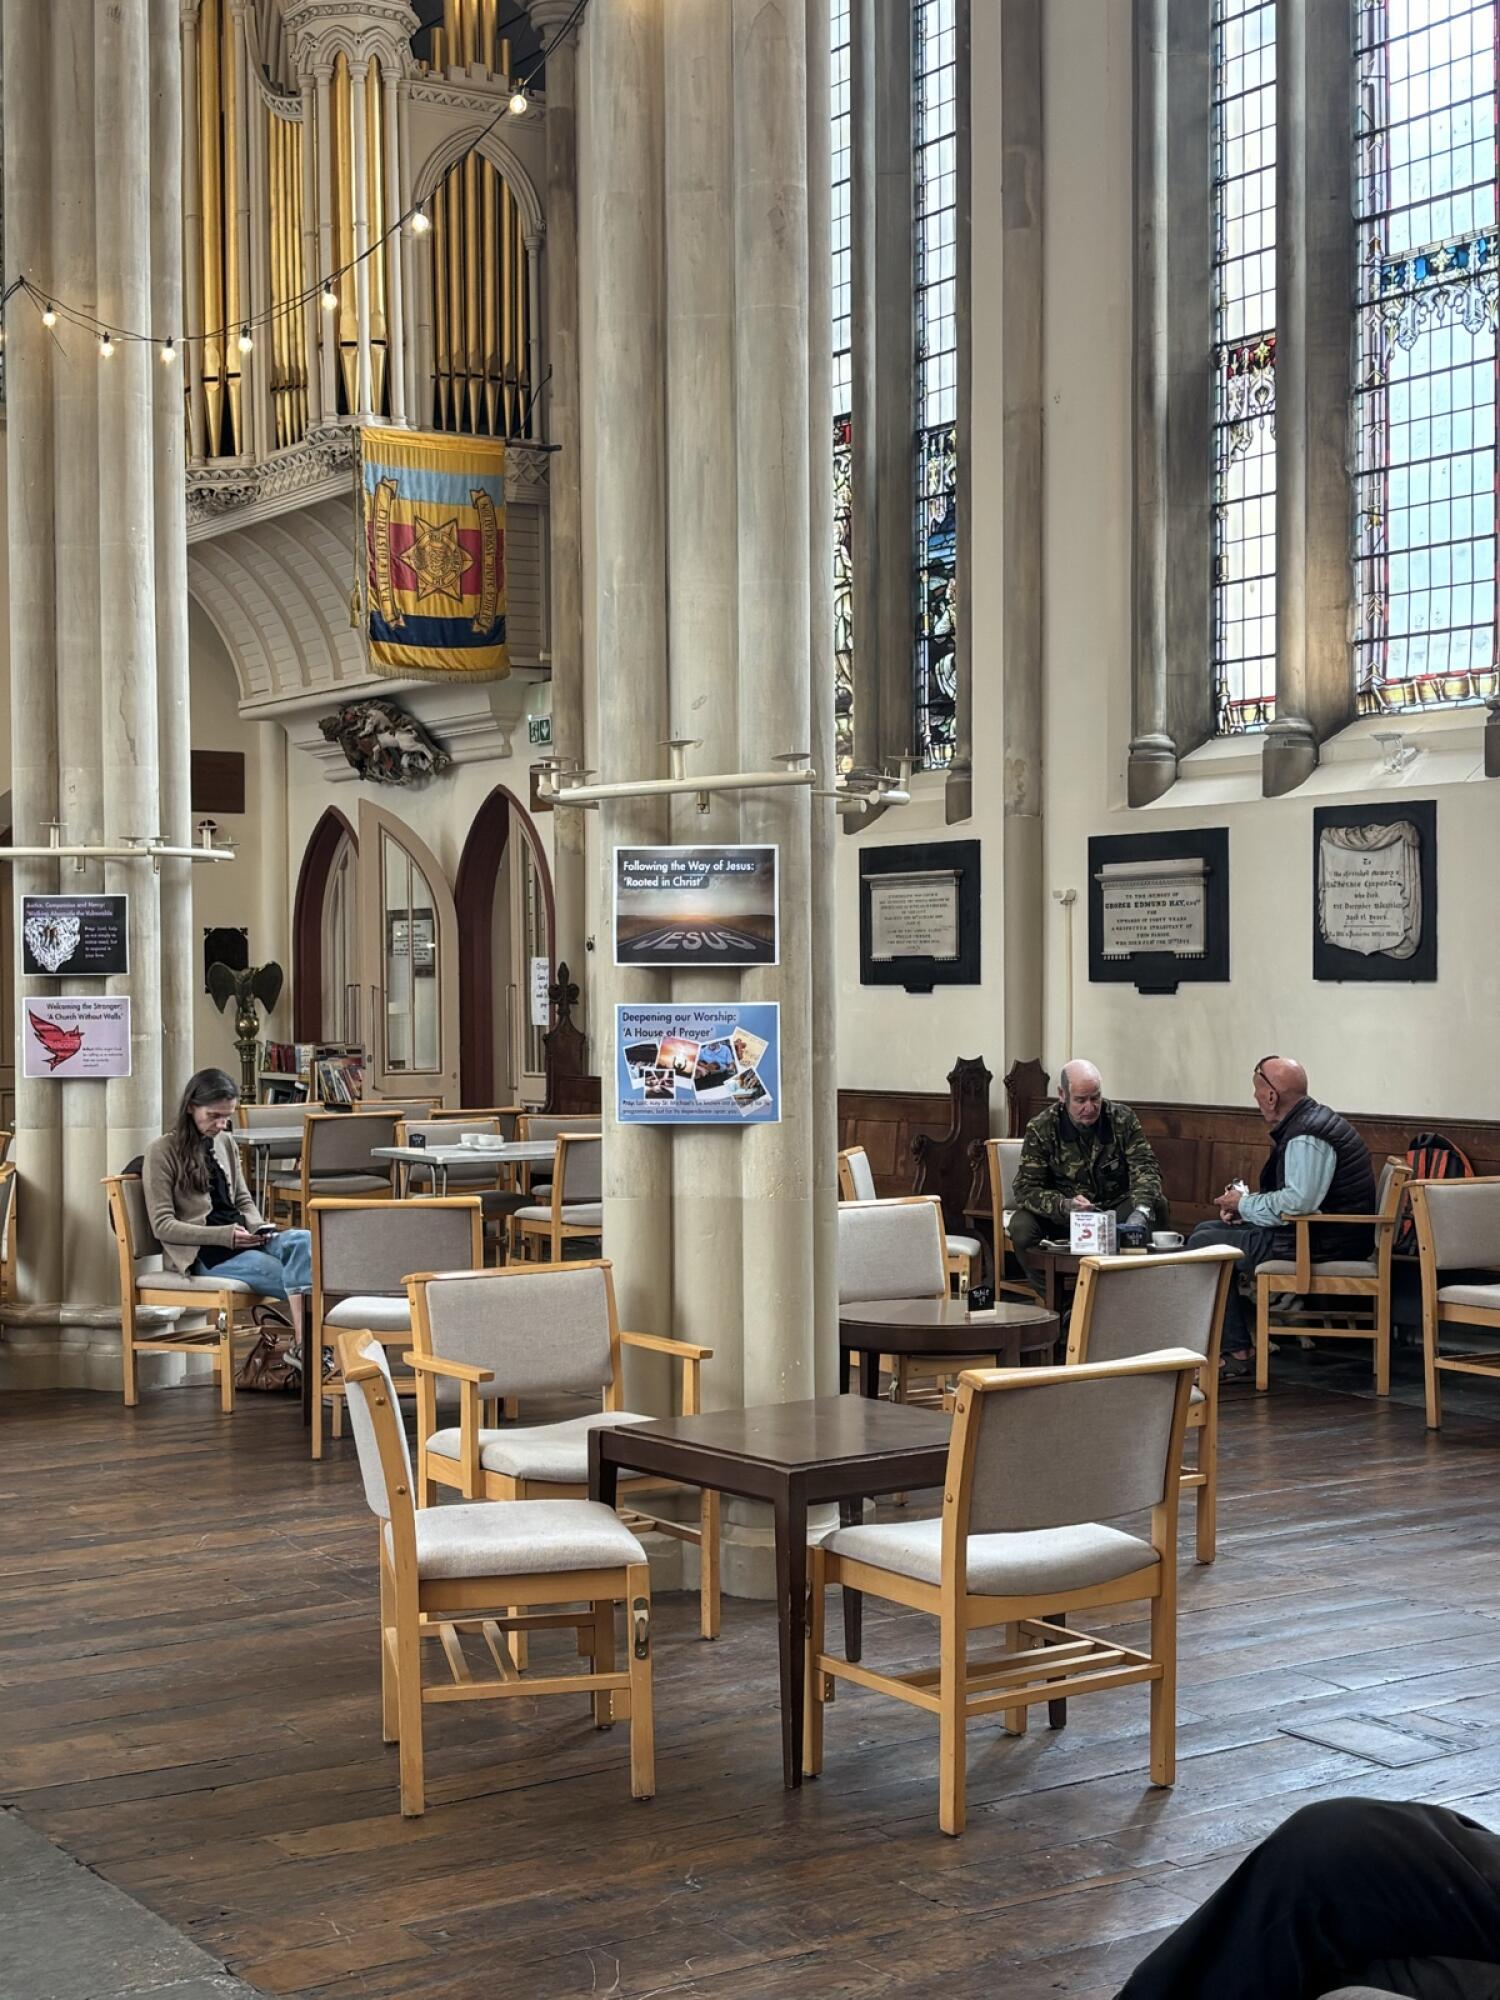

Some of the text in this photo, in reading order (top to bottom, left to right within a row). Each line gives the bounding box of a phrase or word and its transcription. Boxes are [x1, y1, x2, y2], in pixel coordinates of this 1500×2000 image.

[624, 860, 755, 873] Following the Way of Jesus:
[661, 877, 670, 887] in
[1134, 900, 1167, 908] EDMUND
[632, 932, 756, 950] JESUS
[47, 1003, 80, 1012] Welcoming
[55, 1012, 77, 1020] Church
[78, 1012, 101, 1020] Without
[622, 1012, 736, 1025] Deepening our Worship:
[635, 1028, 663, 1037] House
[666, 1027, 676, 1037] of
[972, 1288, 990, 1298] Table
